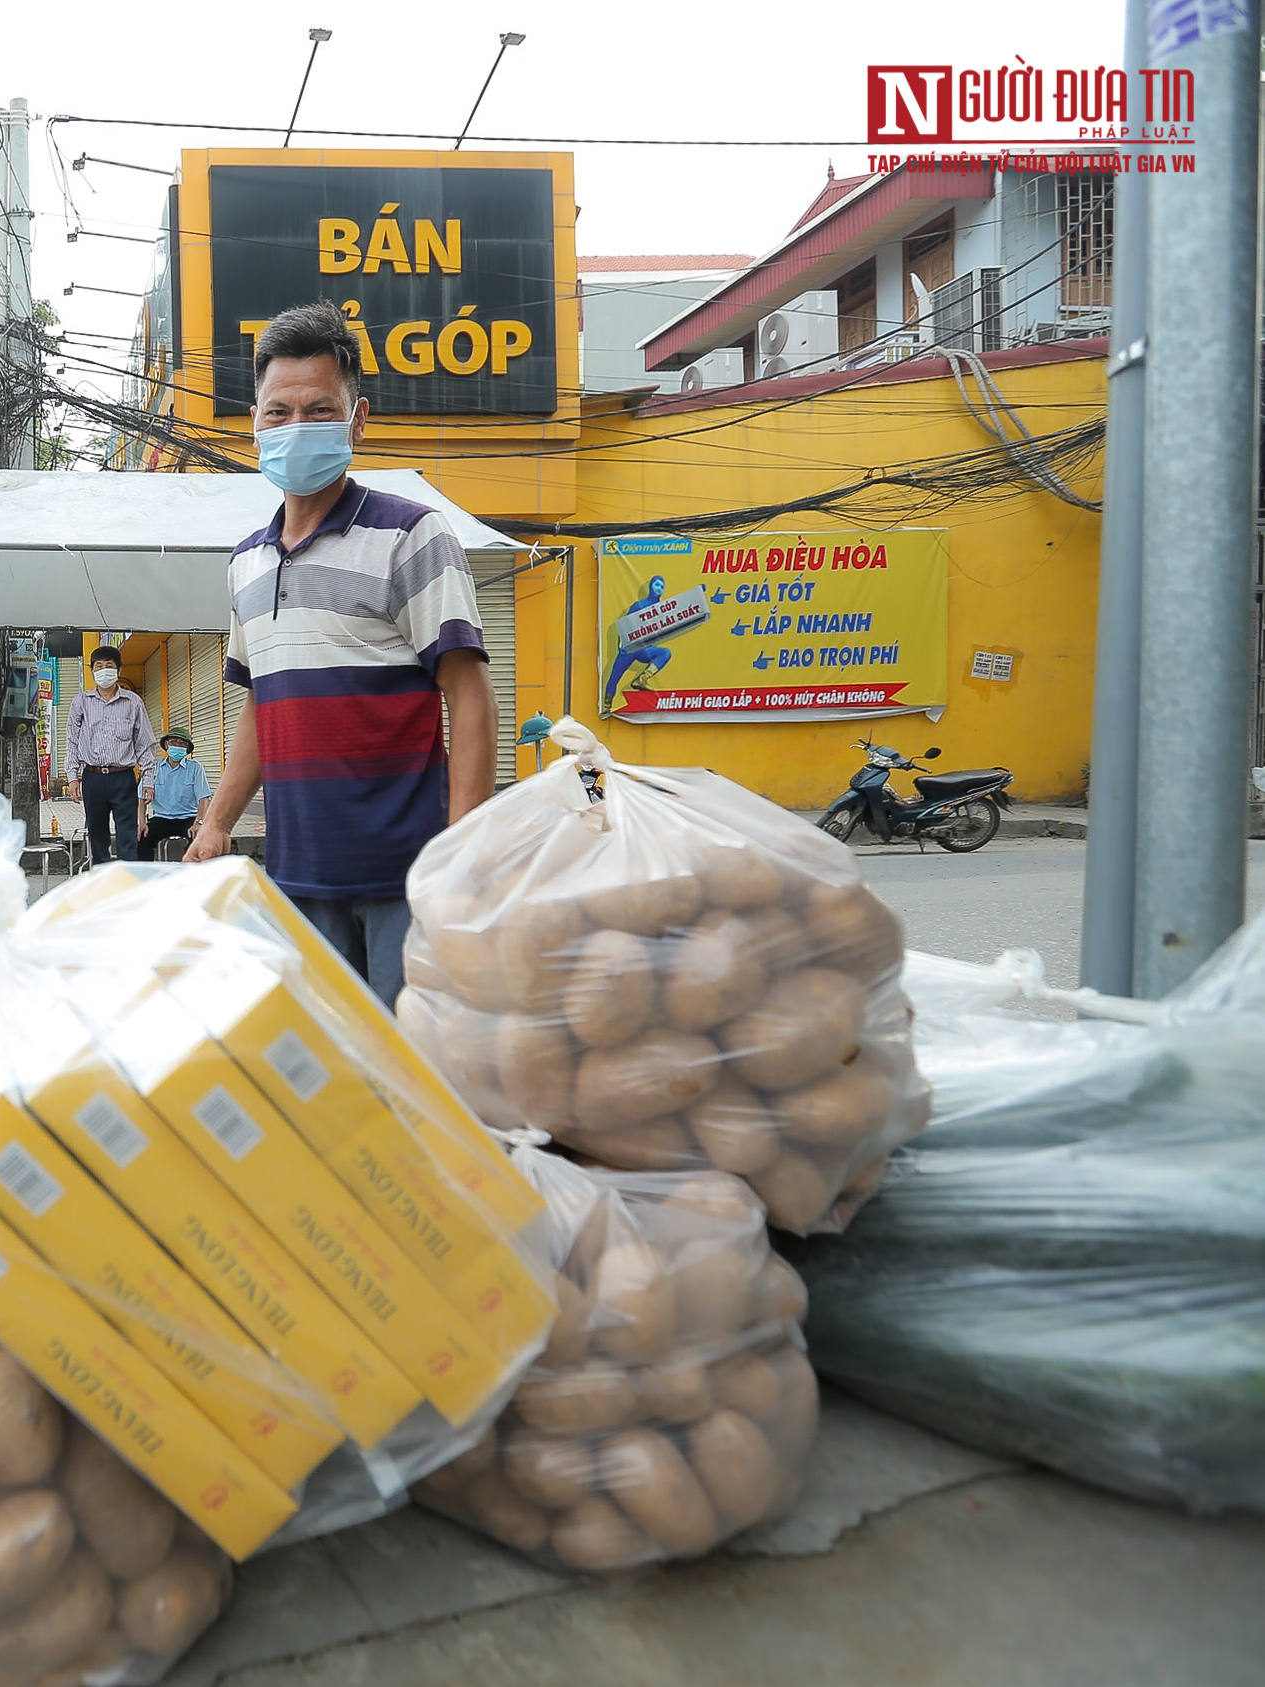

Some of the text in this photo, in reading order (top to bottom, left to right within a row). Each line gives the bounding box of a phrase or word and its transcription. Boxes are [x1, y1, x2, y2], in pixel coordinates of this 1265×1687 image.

[318, 202, 462, 275] BÁN
[385, 305, 533, 376] GÓP
[663, 542, 689, 552] XANH
[702, 535, 887, 574] MUA ĐIỀU HÒA
[735, 573, 816, 604] GIÁ TỐT
[628, 624, 659, 641] KHÔNG
[752, 605, 872, 636] LẮP NHANH
[777, 639, 899, 673] BAO TRỌN PHÍ
[656, 692, 682, 709] MIỄN
[684, 693, 703, 708] PHÍ
[704, 695, 730, 708] GIAO
[733, 690, 752, 706] LẮP
[764, 694, 791, 706] 100%
[794, 690, 814, 705] HÚT
[816, 690, 845, 704] CHÂN
[846, 690, 885, 703] KHÔNG
